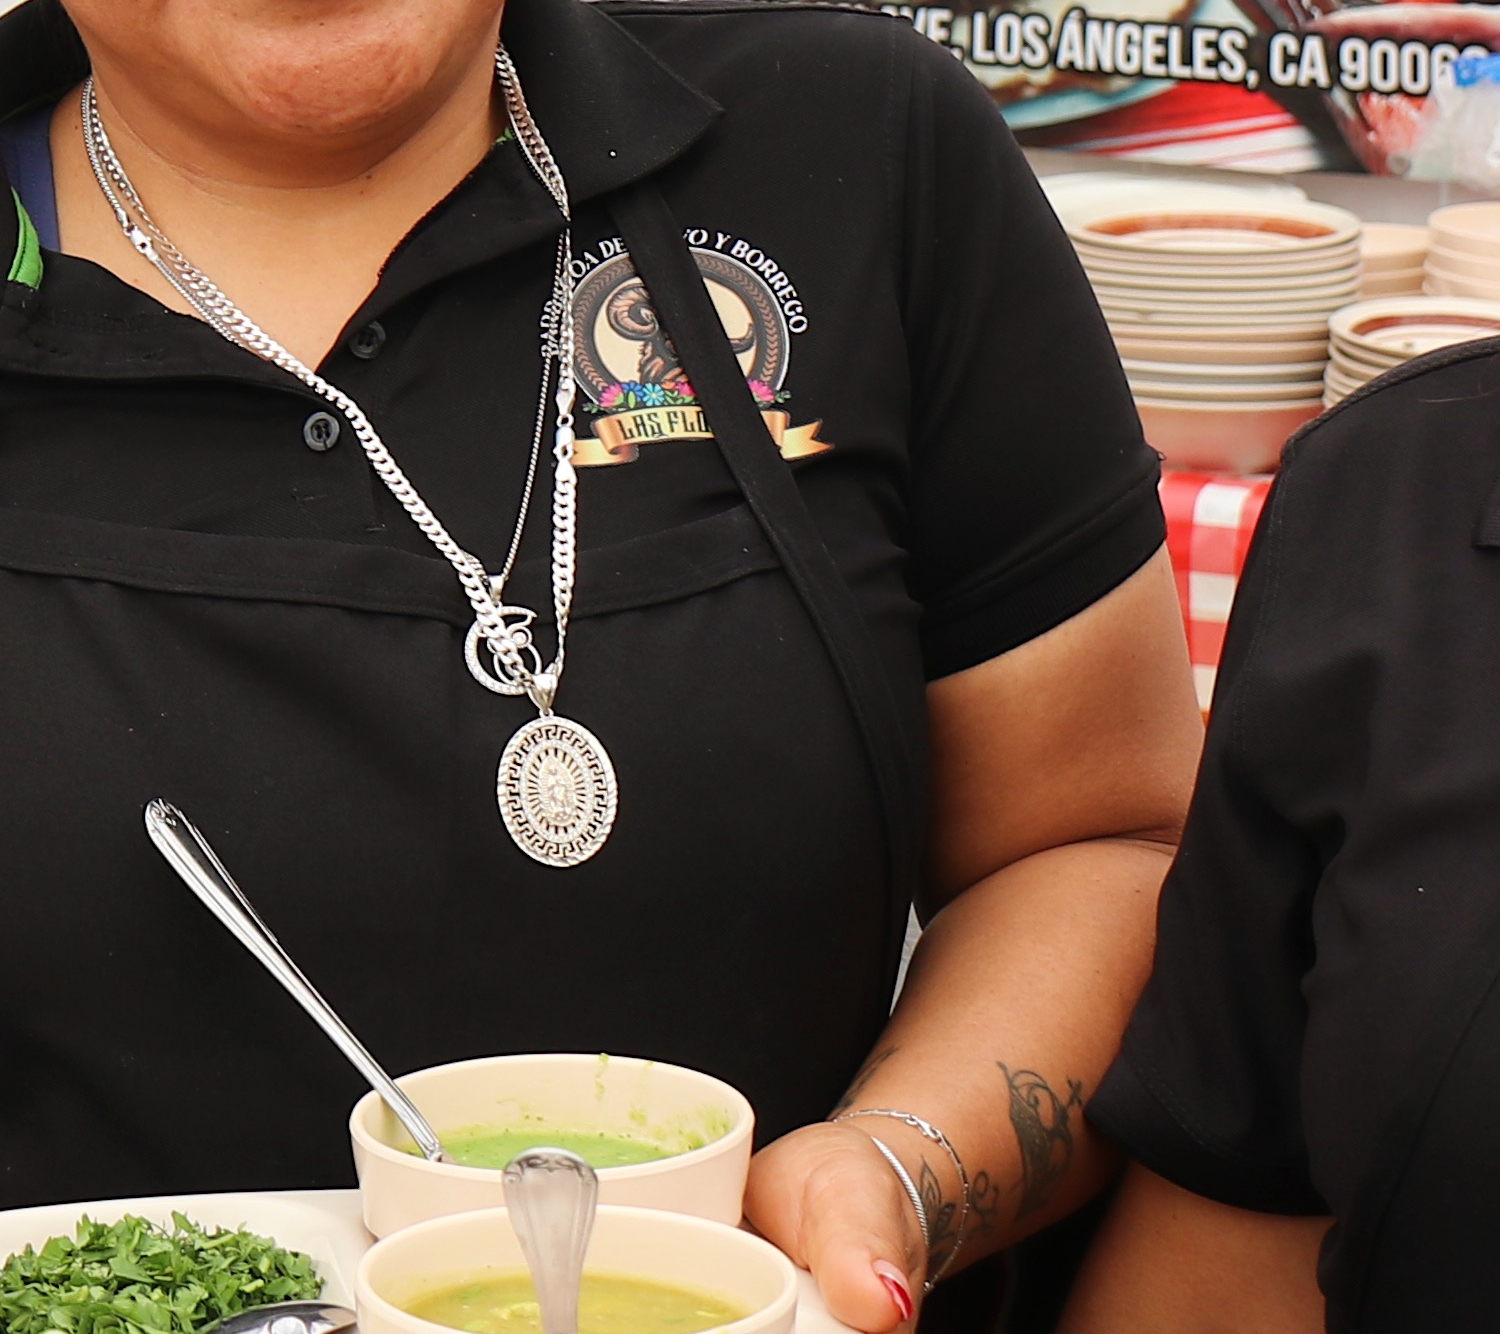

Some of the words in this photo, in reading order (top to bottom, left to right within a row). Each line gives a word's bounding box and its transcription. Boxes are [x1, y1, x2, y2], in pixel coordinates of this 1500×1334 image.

[972, 12, 1051, 67] LOS
[1055, 8, 1258, 90] ÁNGELES,
[1270, 32, 1331, 89] CA
[715, 231, 731, 250] Y
[730, 238, 809, 335] BORREGO
[616, 412, 668, 440] LAS
